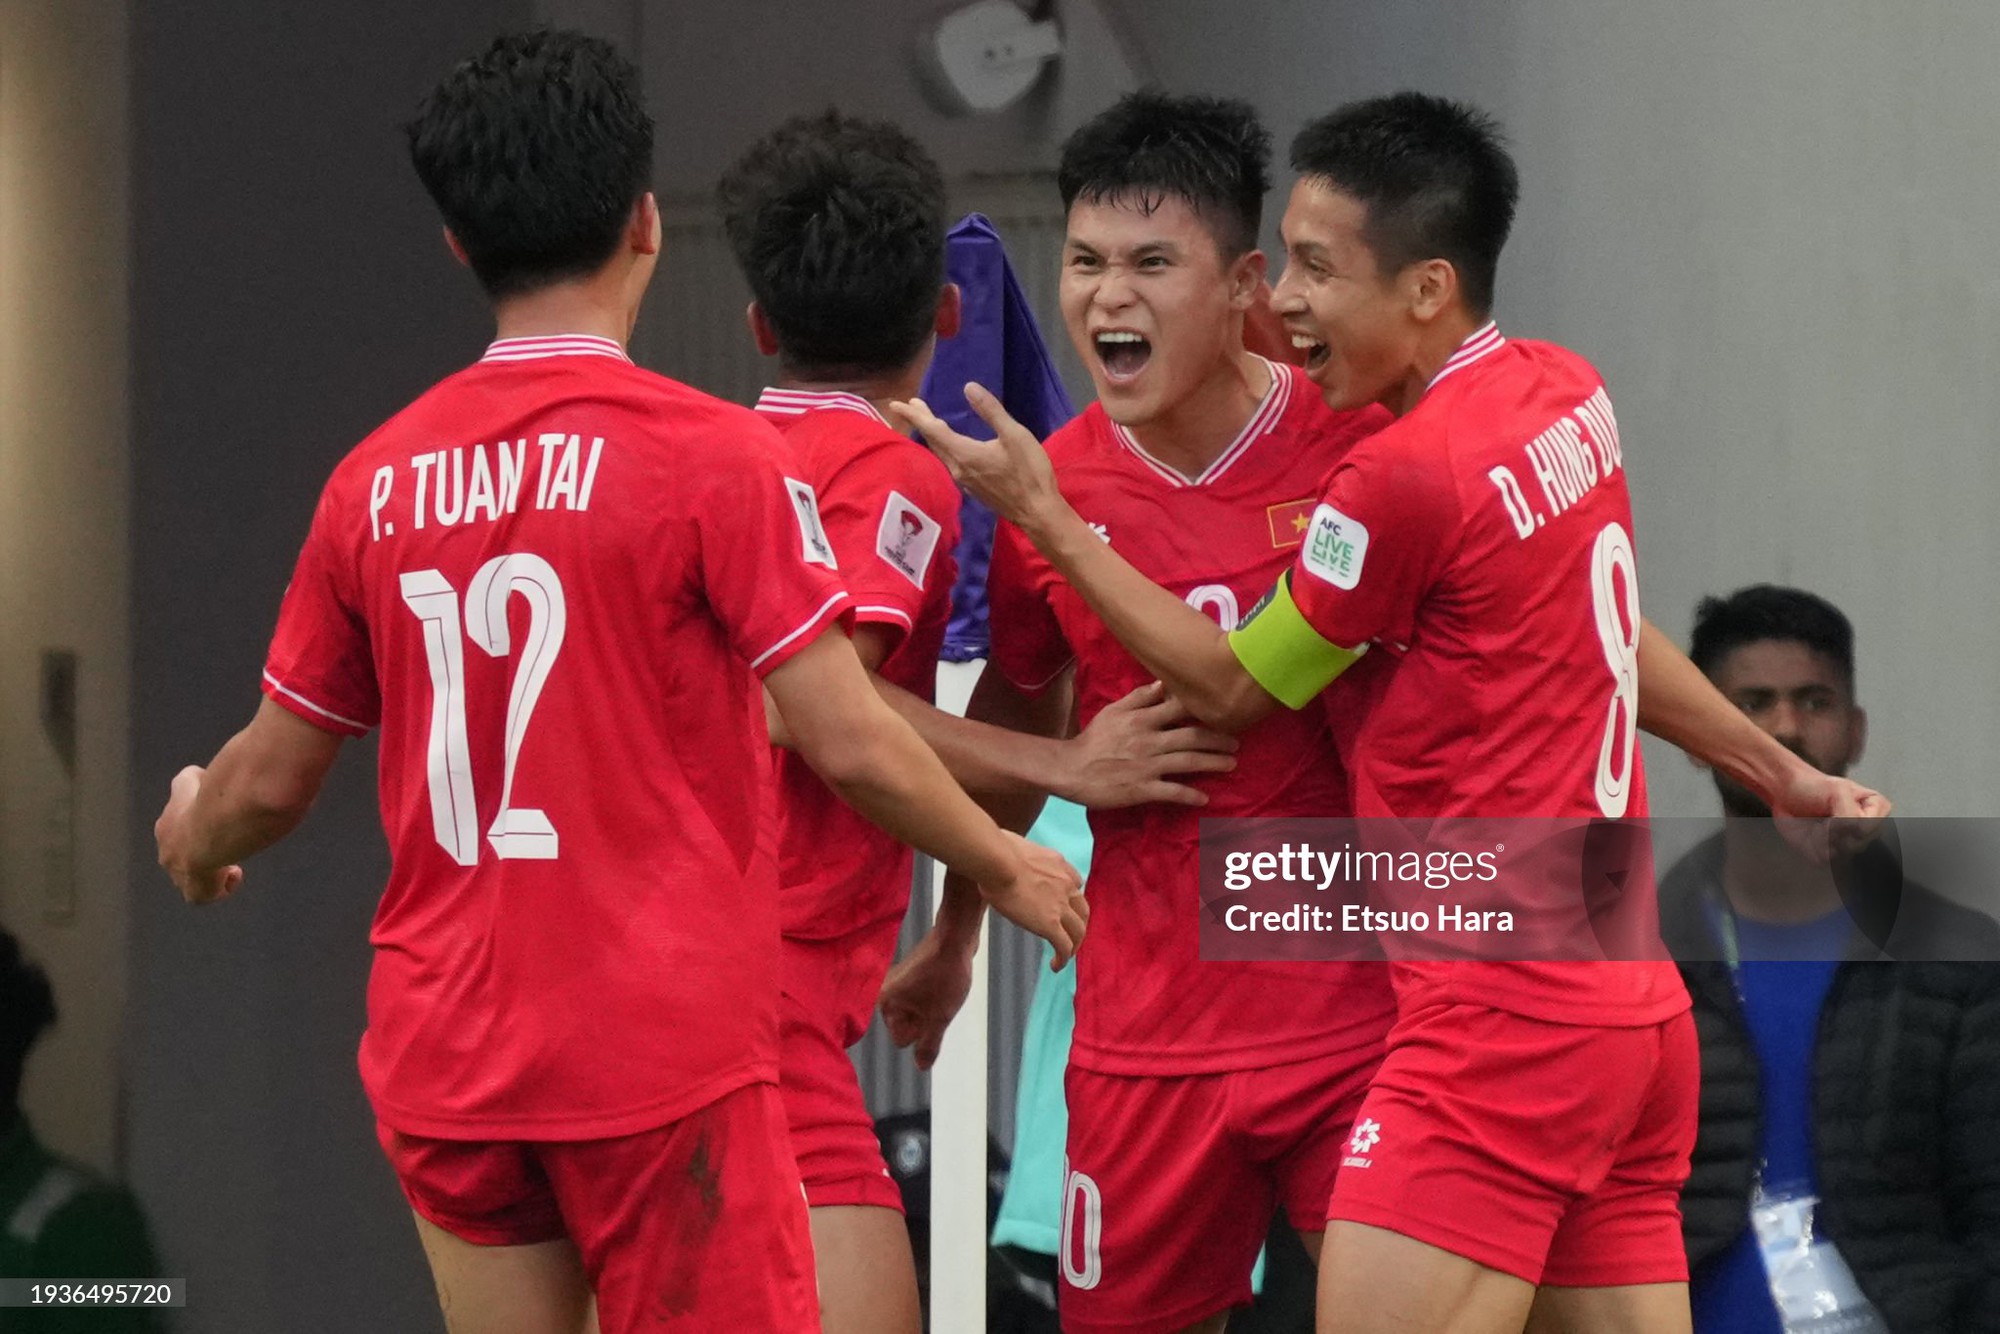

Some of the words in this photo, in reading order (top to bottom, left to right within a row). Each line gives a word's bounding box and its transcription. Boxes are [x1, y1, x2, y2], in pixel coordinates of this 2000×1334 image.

[370, 465, 394, 542] P.
[411, 438, 526, 529] TUAN
[537, 433, 604, 511] TAI
[1320, 517, 1342, 536] AFC
[1488, 465, 1546, 540] D.
[1525, 416, 1598, 517] HUNG
[1573, 385, 1622, 478] DU
[1315, 529, 1354, 561] LIVE
[399, 552, 566, 866] 12
[1590, 521, 1641, 820] 8
[1058, 1153, 1102, 1290] 0
